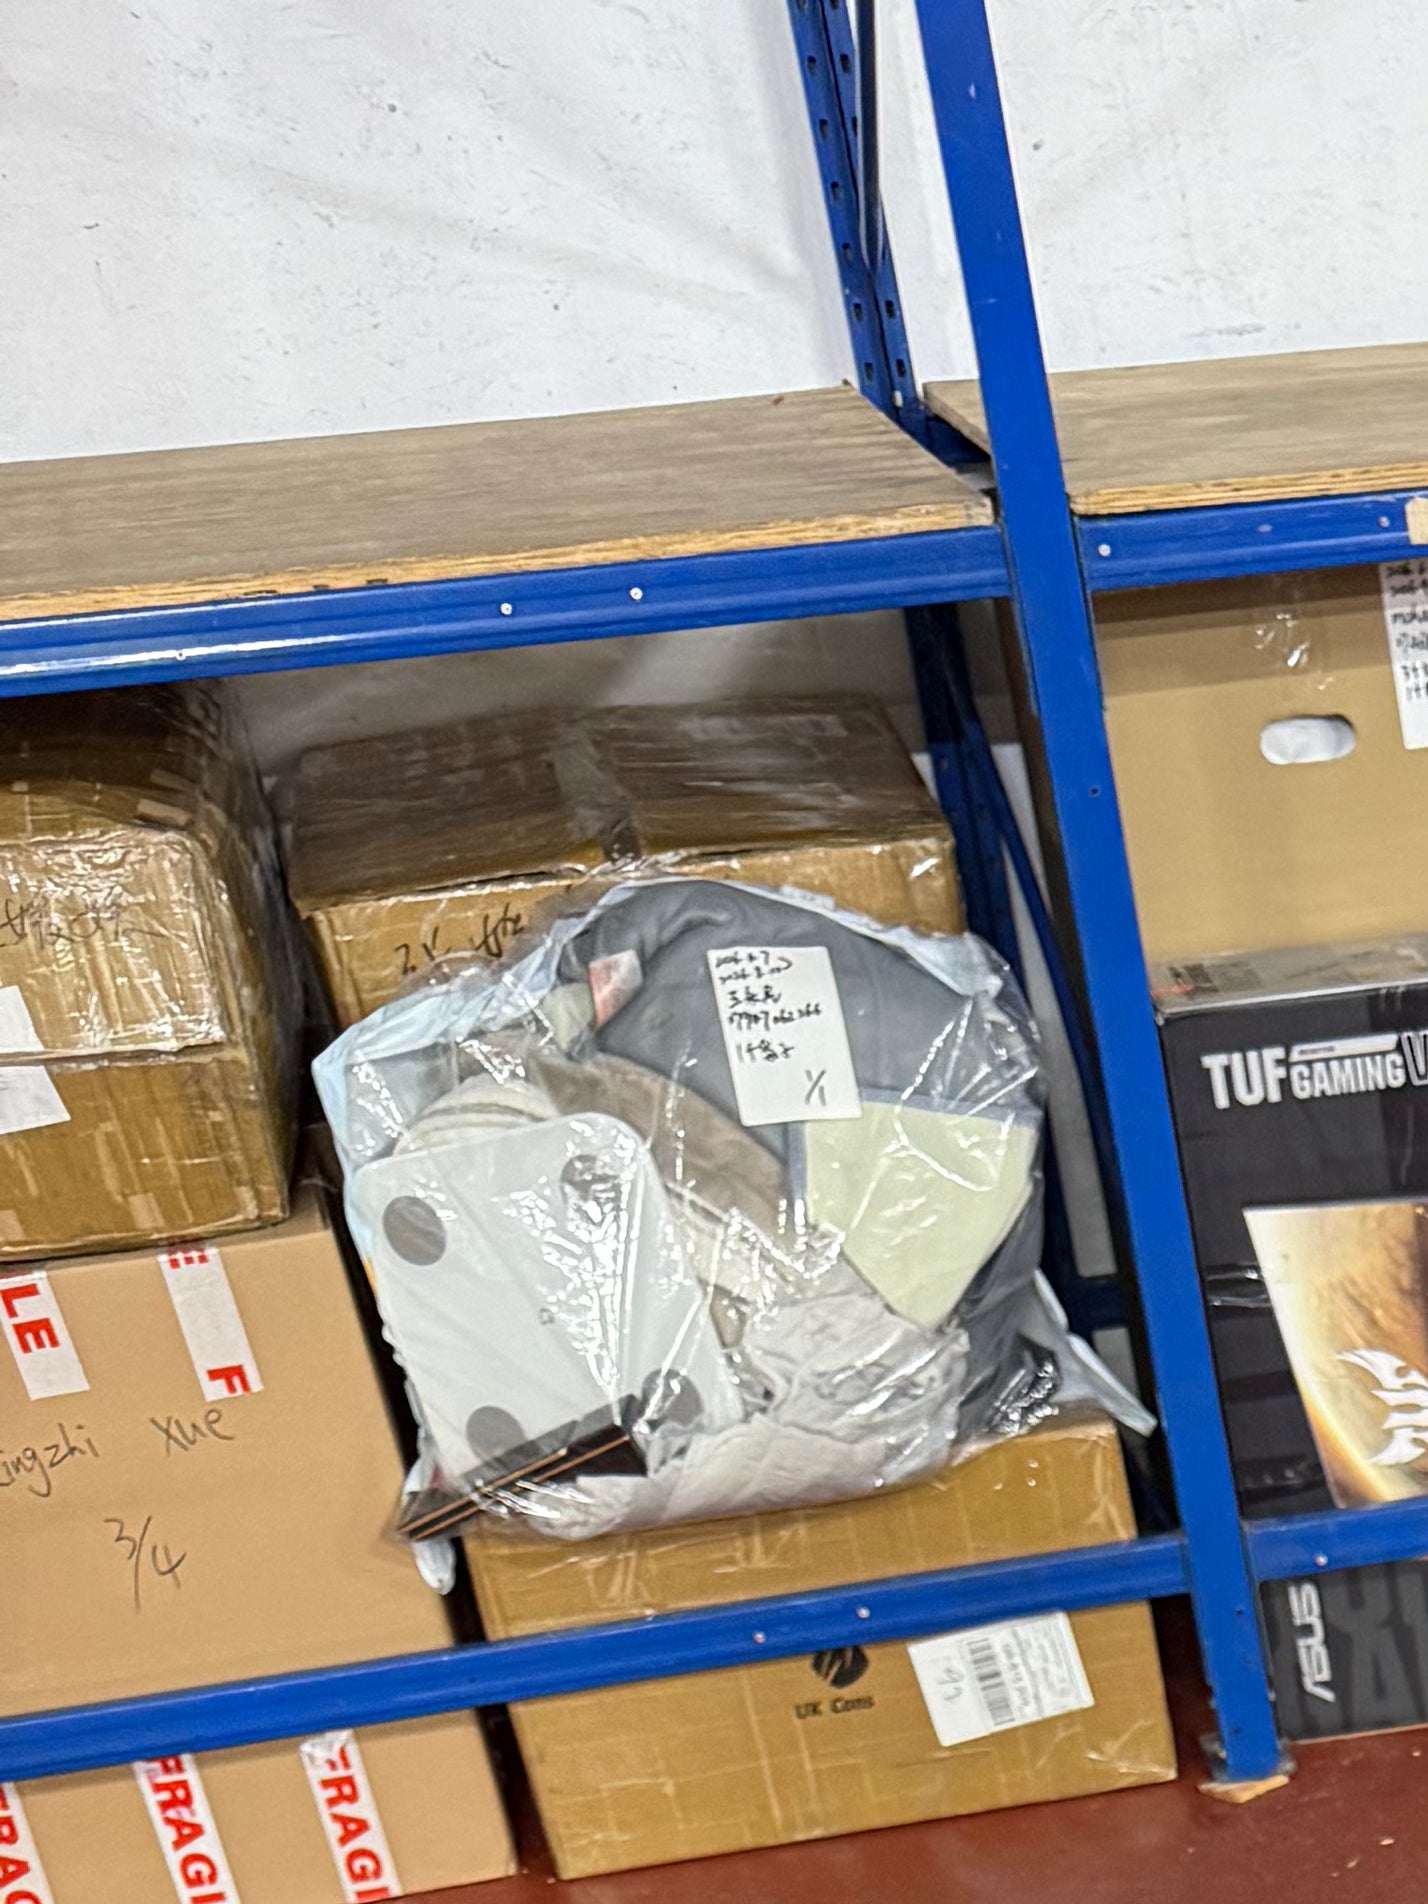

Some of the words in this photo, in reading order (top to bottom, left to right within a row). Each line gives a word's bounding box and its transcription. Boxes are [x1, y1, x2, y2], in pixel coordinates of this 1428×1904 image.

[1200, 1045, 1288, 1110] TUF
[1289, 1051, 1407, 1101] GAMING
[103, 1515, 187, 1614] 3/4
[1287, 1581, 1337, 1703] ASUS
